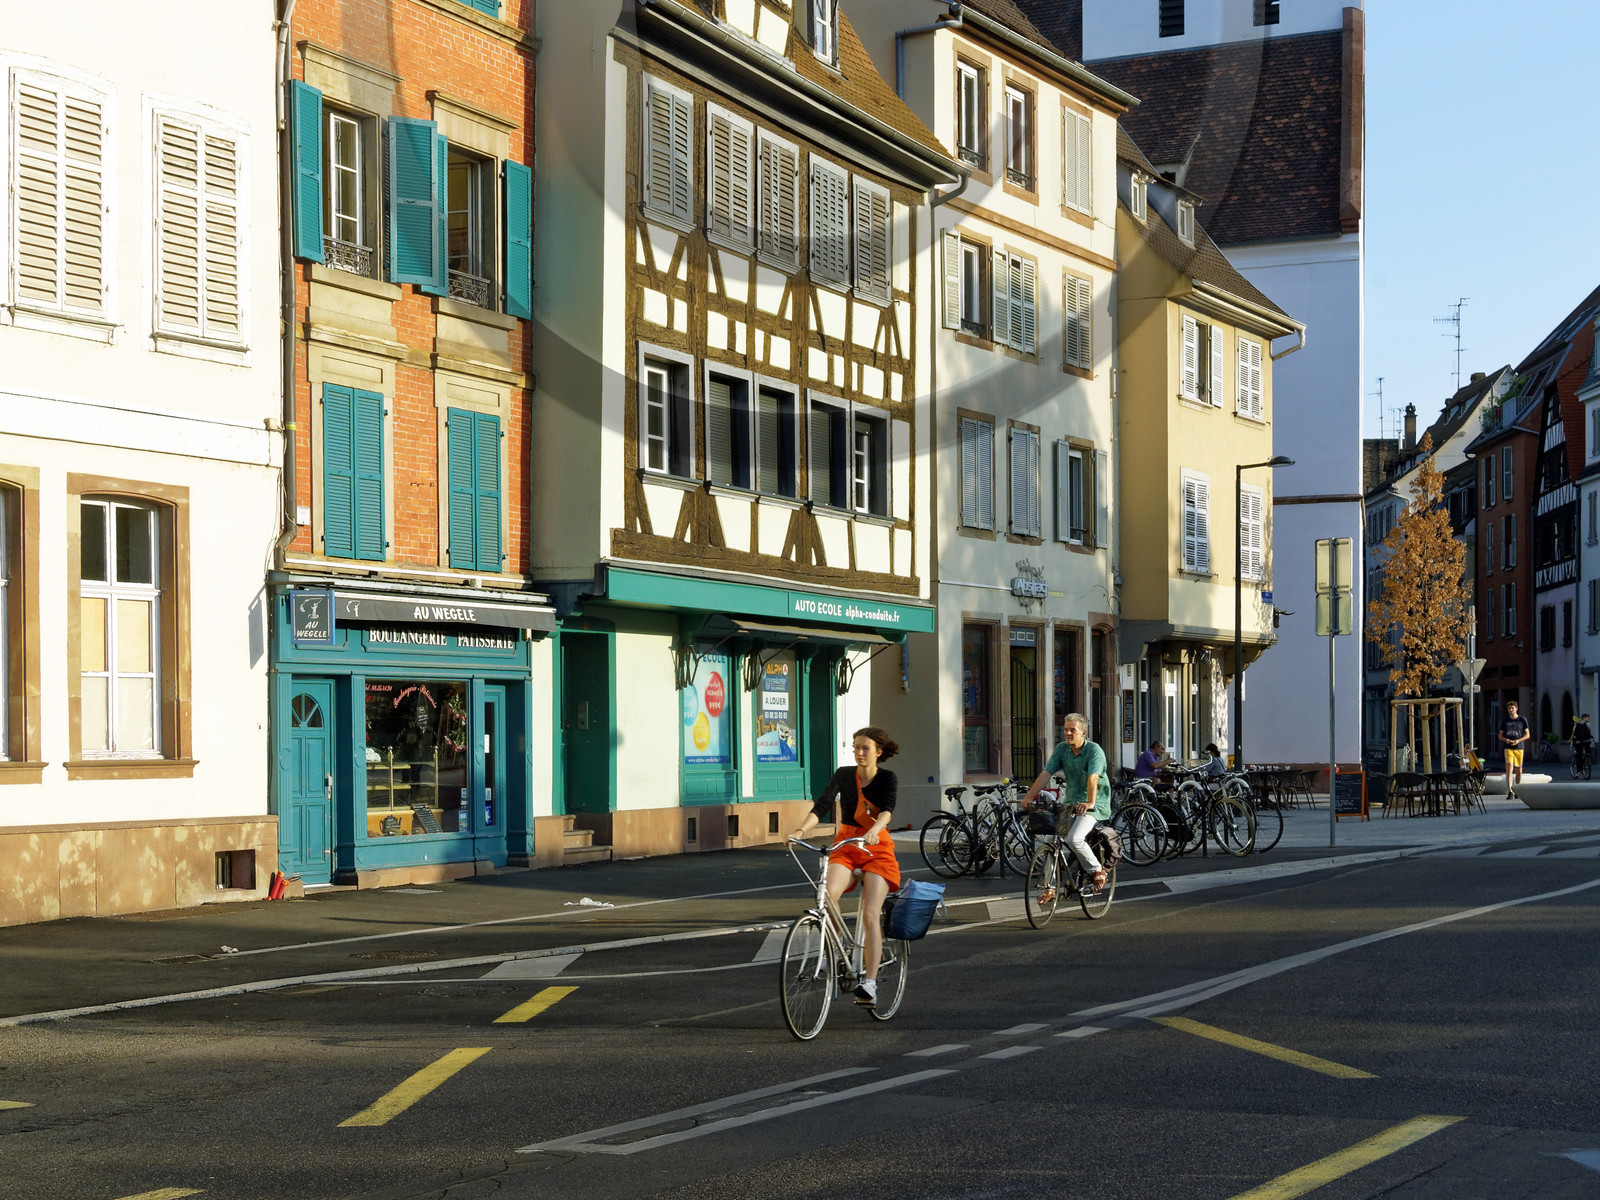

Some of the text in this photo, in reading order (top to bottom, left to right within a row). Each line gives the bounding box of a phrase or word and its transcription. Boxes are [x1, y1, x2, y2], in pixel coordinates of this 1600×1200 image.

[413, 606, 477, 621] AU WEGELE
[795, 599, 900, 623] AUTO ECOLE alpha-conduite.fr
[305, 621, 318, 629] AU
[296, 630, 327, 638] WEGELE
[369, 626, 514, 650] BOULANGERIE PATISSERIE
[702, 652, 726, 664] ECOLE
[770, 696, 787, 706] LOUER
